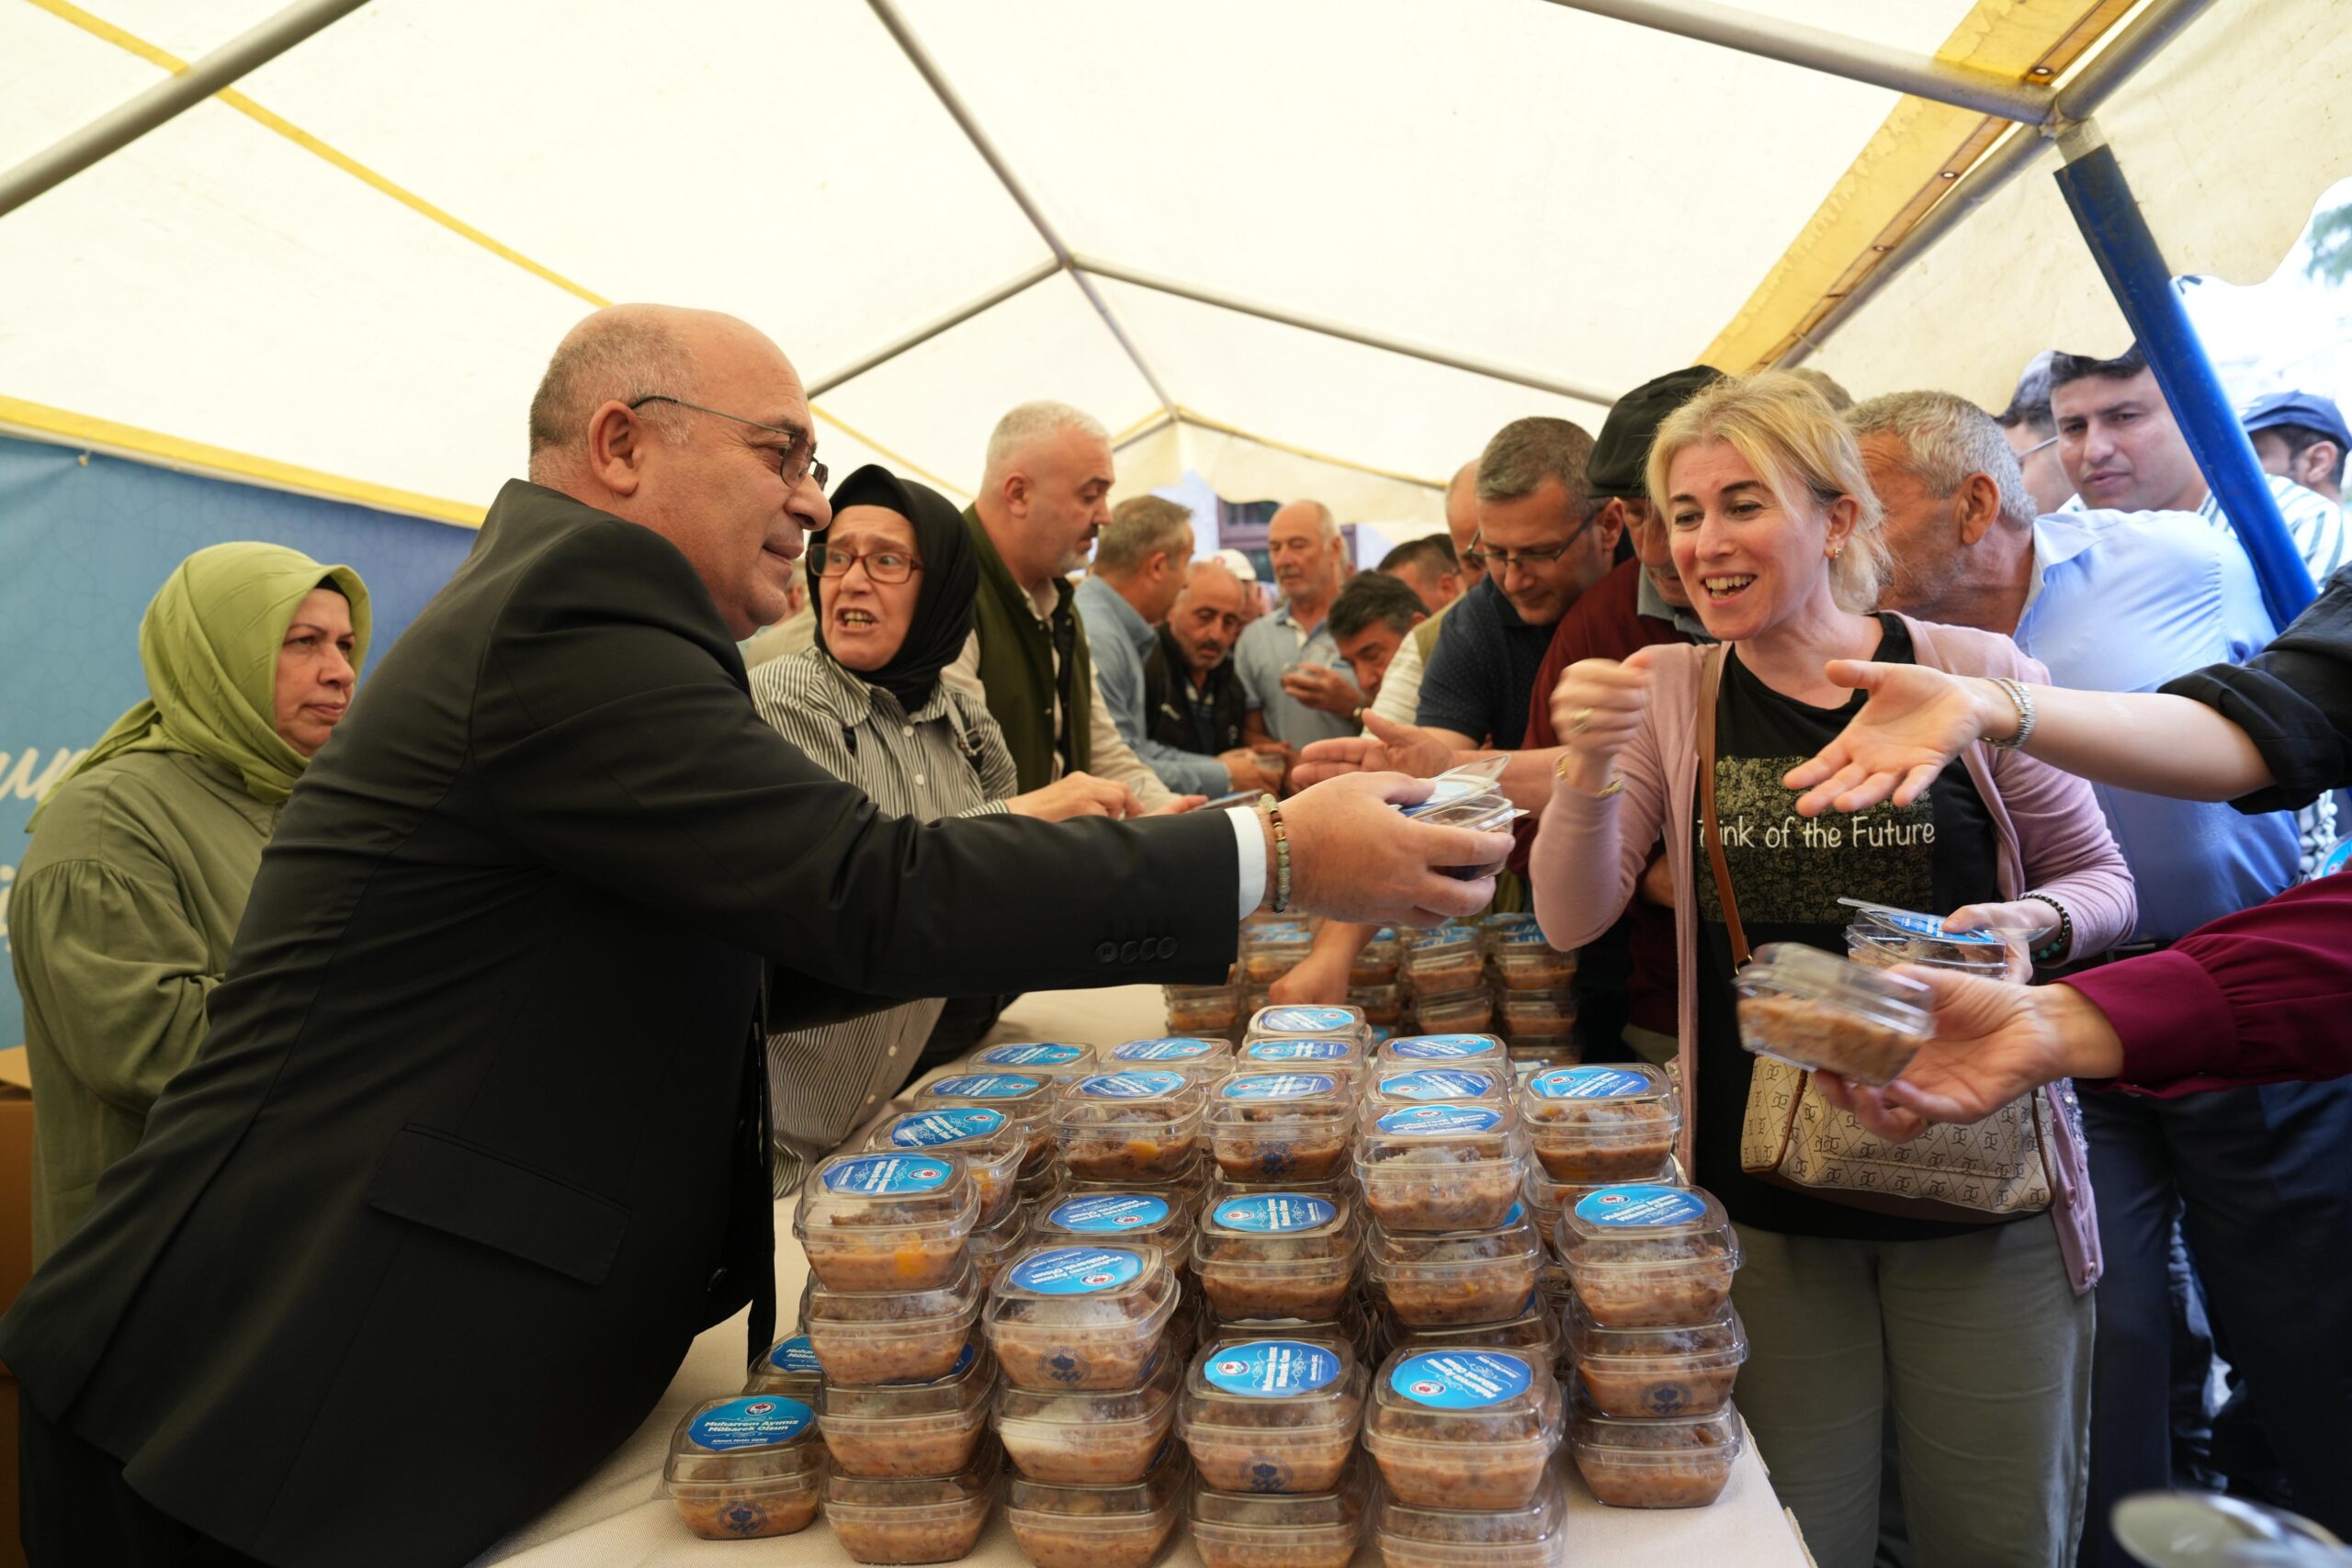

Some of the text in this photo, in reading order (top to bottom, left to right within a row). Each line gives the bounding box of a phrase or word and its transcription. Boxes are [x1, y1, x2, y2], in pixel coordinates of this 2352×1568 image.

[1697, 815, 1936, 849] Tink of the Future
